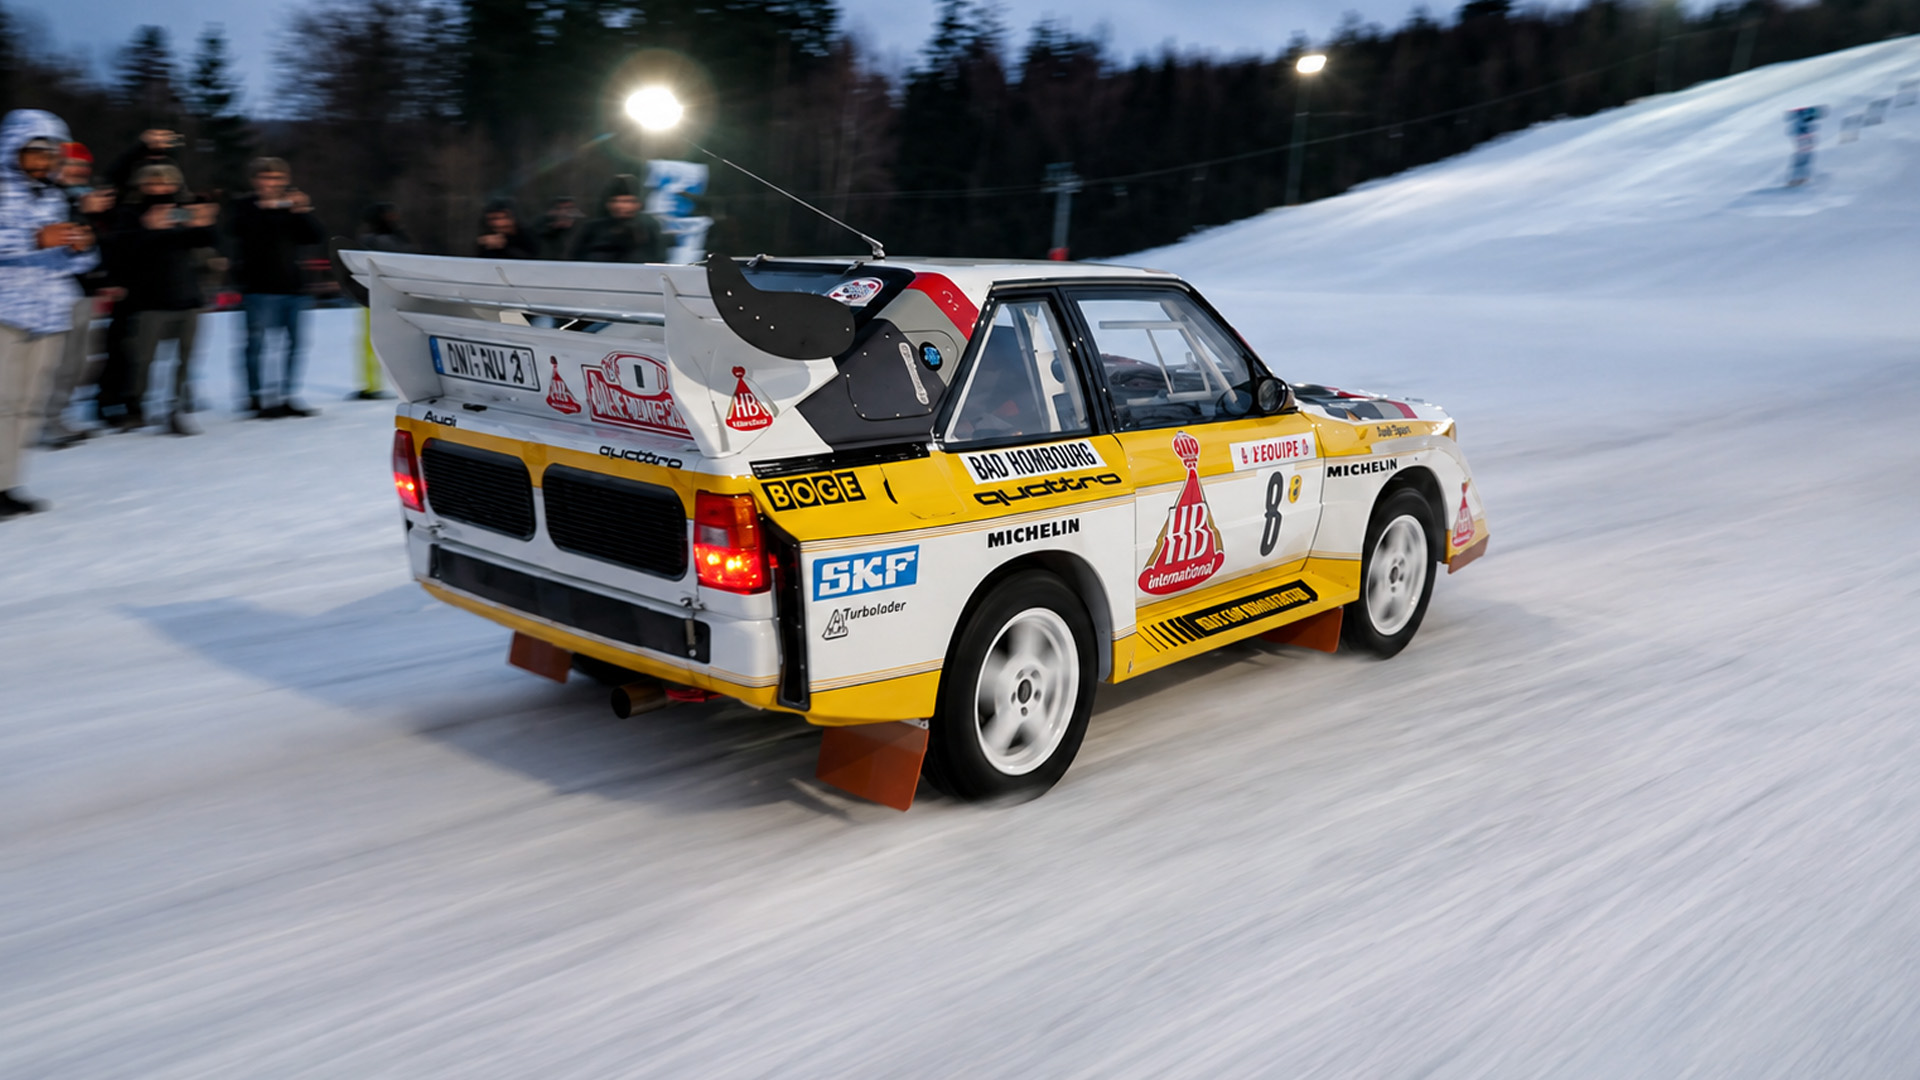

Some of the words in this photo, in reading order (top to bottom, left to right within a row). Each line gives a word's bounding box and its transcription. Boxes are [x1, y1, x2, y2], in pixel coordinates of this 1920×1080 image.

[423, 410, 457, 428] Audi
[733, 392, 760, 418] HB
[598, 445, 684, 470] quattro
[968, 453, 1010, 481] BAD
[1004, 442, 1098, 476] HOMBOURG
[1326, 458, 1398, 478] MICHELIN
[766, 475, 862, 508] BOGE
[973, 473, 1122, 507] quattro
[1259, 470, 1284, 557] 8
[986, 517, 1081, 549] MICHELIN
[1164, 501, 1215, 566] HB
[818, 550, 917, 597] SKF
[1147, 555, 1217, 590] international
[842, 601, 907, 621] Turbolader
